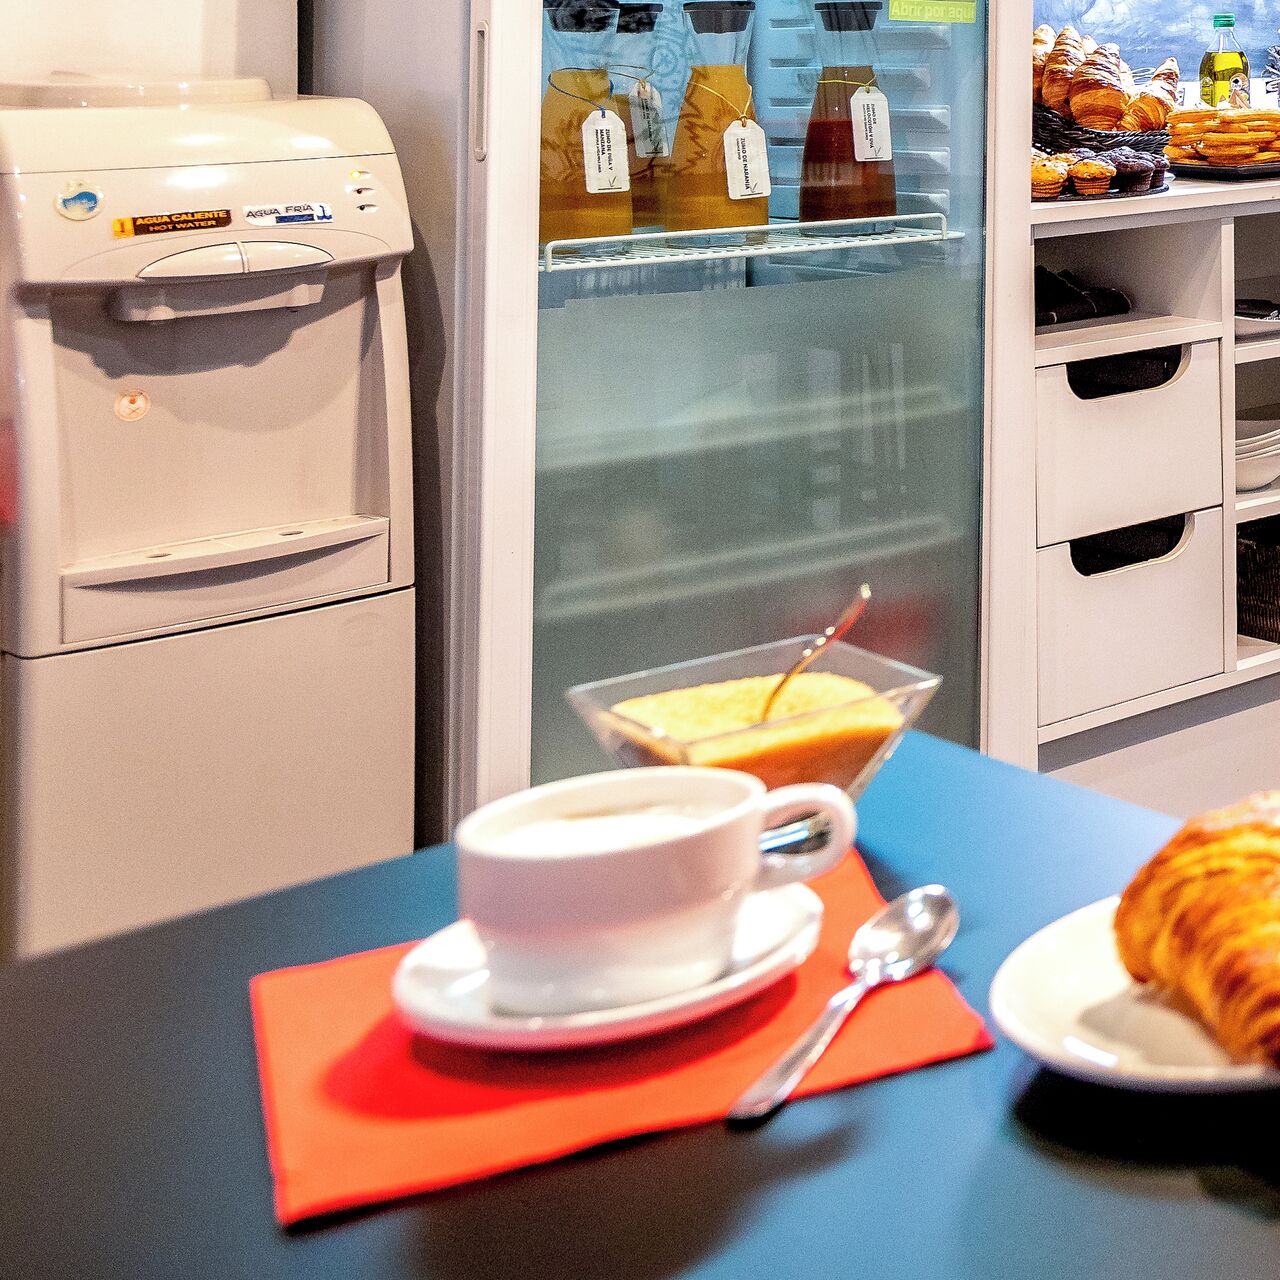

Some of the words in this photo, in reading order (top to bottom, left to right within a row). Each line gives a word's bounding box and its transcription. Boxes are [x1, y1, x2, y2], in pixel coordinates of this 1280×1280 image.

[136, 216, 169, 225] AGUA
[171, 210, 228, 221] CALIENTE
[246, 209, 281, 218] AGUA
[149, 223, 172, 232] HOT
[174, 220, 217, 229] WATER
